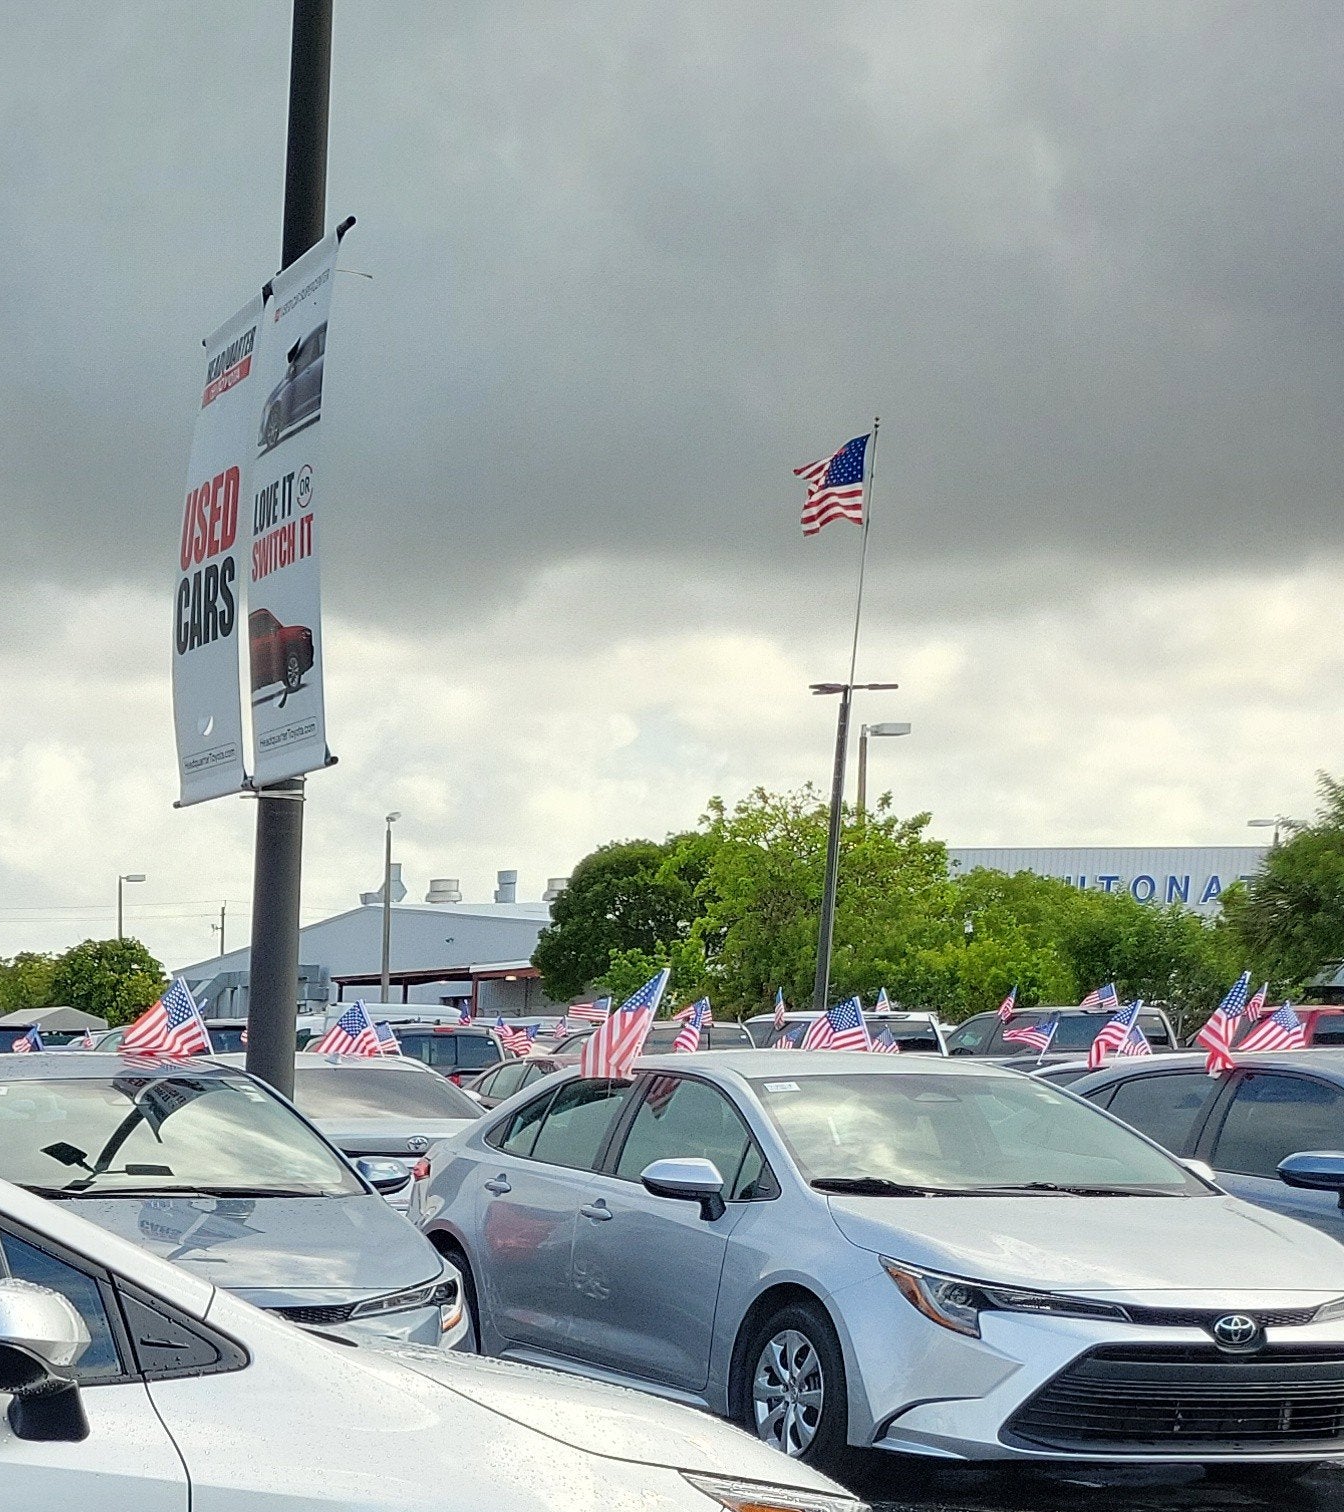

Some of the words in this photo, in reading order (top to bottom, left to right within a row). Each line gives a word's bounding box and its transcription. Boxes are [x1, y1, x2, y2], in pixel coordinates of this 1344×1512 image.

[180, 465, 240, 572] USED
[253, 481, 279, 536] LOVE
[281, 471, 295, 519] IT
[299, 476, 310, 497] OR
[251, 521, 296, 582] SWITCH
[300, 513, 314, 559] IT
[176, 556, 235, 656] CARS
